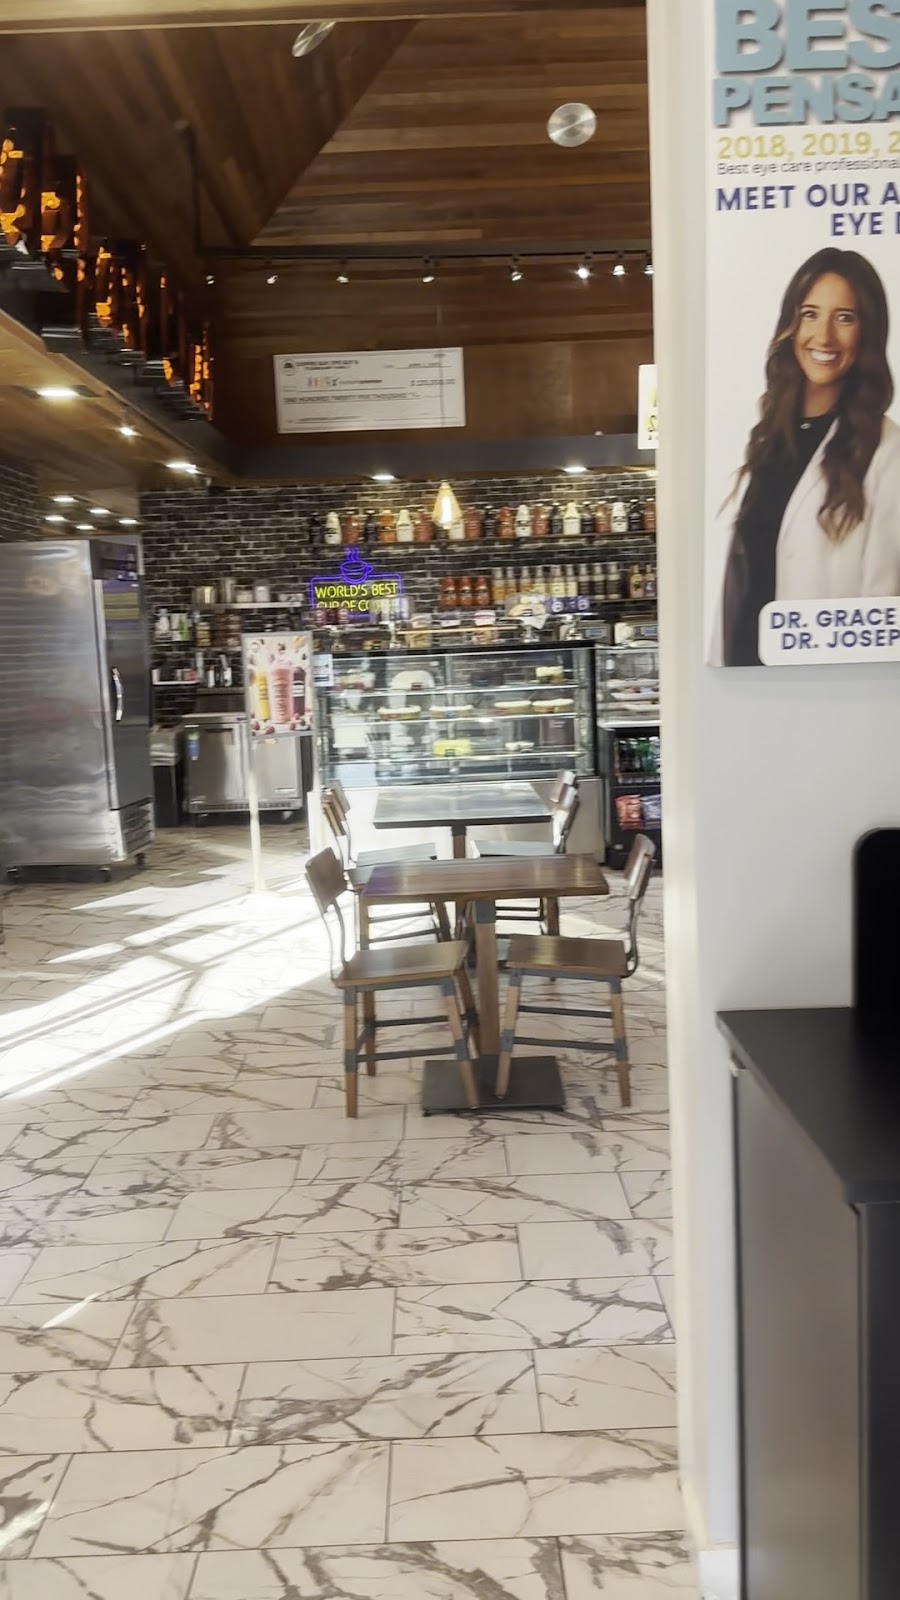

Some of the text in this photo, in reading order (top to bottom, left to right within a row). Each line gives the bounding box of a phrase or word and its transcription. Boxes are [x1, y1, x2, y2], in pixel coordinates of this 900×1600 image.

[717, 134, 794, 161] 2018,
[802, 132, 880, 158] 2019,
[718, 163, 749, 175] Best
[752, 162, 777, 176] eye
[780, 161, 812, 173] care
[717, 185, 795, 211] MEET
[807, 183, 869, 207] OUR
[831, 212, 884, 236] EYE
[315, 583, 398, 599] WORLD'S BEST
[770, 608, 896, 630] DR. GRACE
[782, 632, 819, 650] DR.
